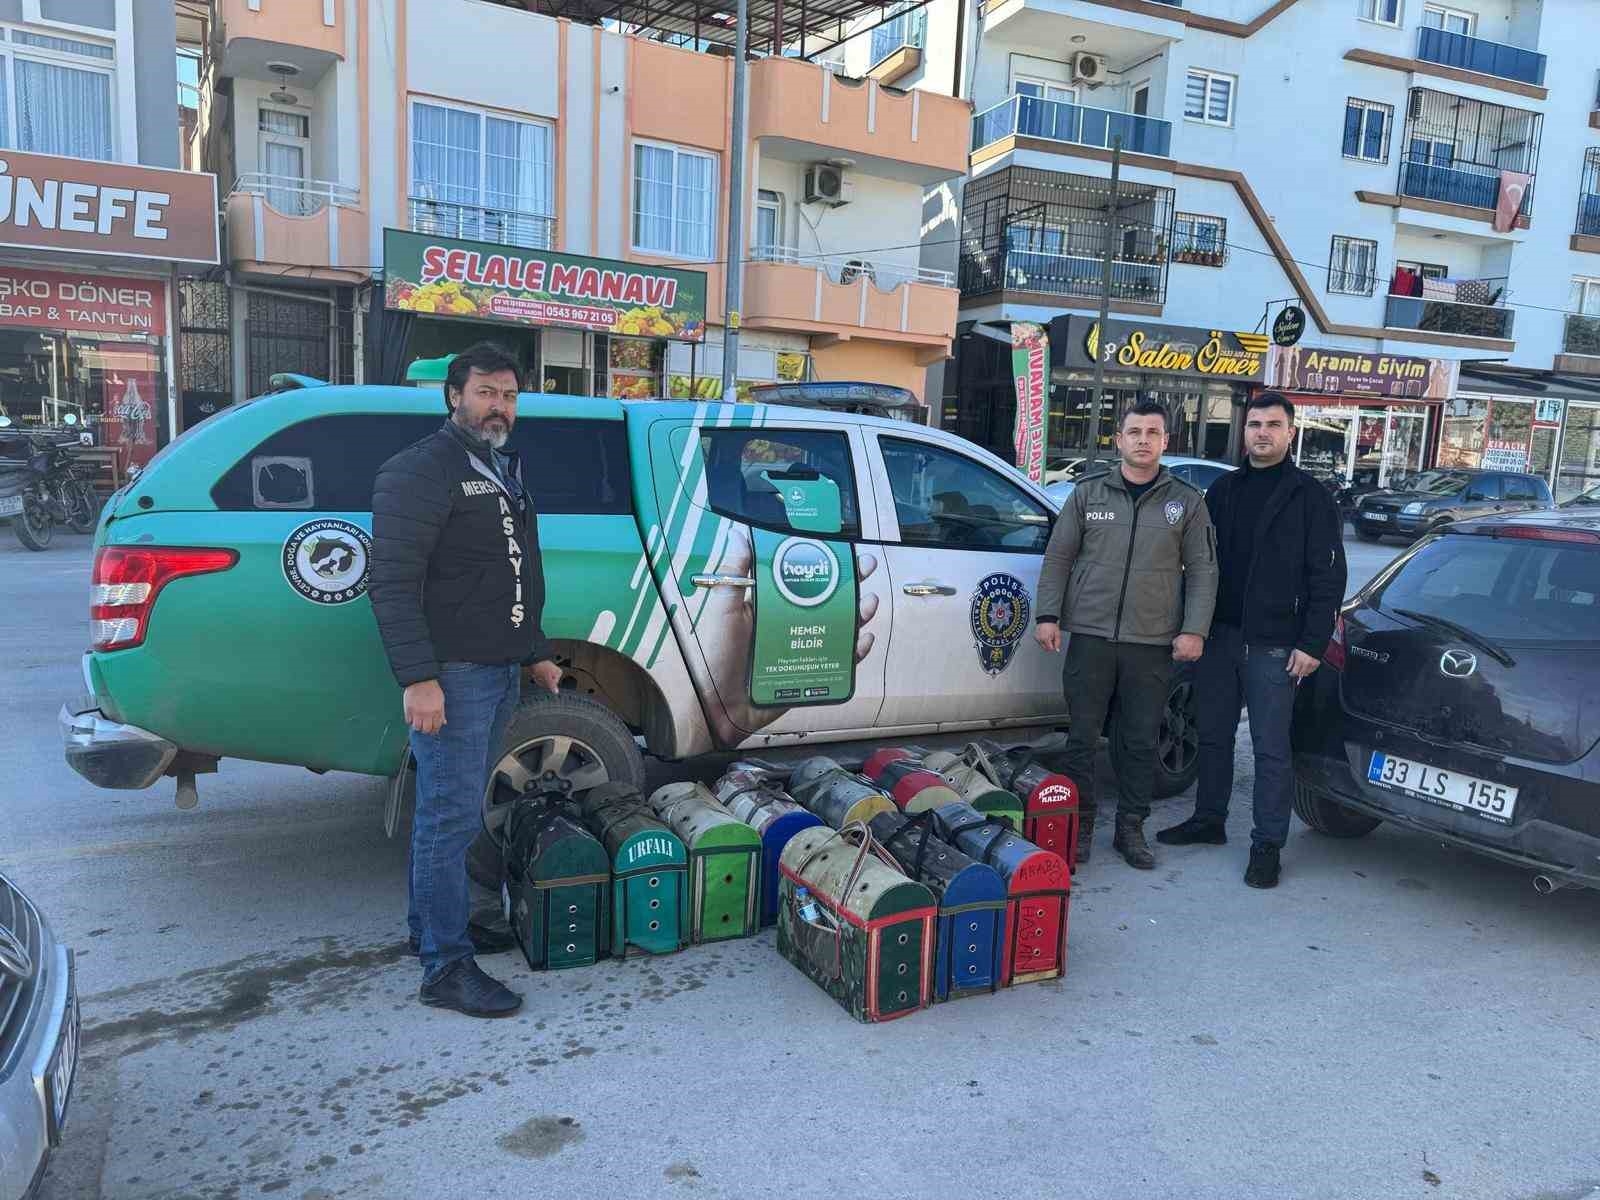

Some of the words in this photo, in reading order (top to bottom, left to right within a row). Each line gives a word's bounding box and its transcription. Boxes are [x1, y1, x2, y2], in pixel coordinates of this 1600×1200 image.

[58, 280, 152, 308] DÖNER
[549, 262, 678, 308] MANAVI
[0, 303, 41, 318] BAP
[47, 306, 60, 320] &
[546, 306, 570, 318] 0543
[590, 311, 600, 321] 21
[601, 312, 613, 322] 05
[1118, 331, 1193, 370] Salon
[1197, 331, 1261, 376] Ömer
[791, 625, 825, 635] HEMEN
[1383, 758, 1409, 784] 33
[1419, 767, 1449, 796] LS
[1468, 781, 1507, 813] 155
